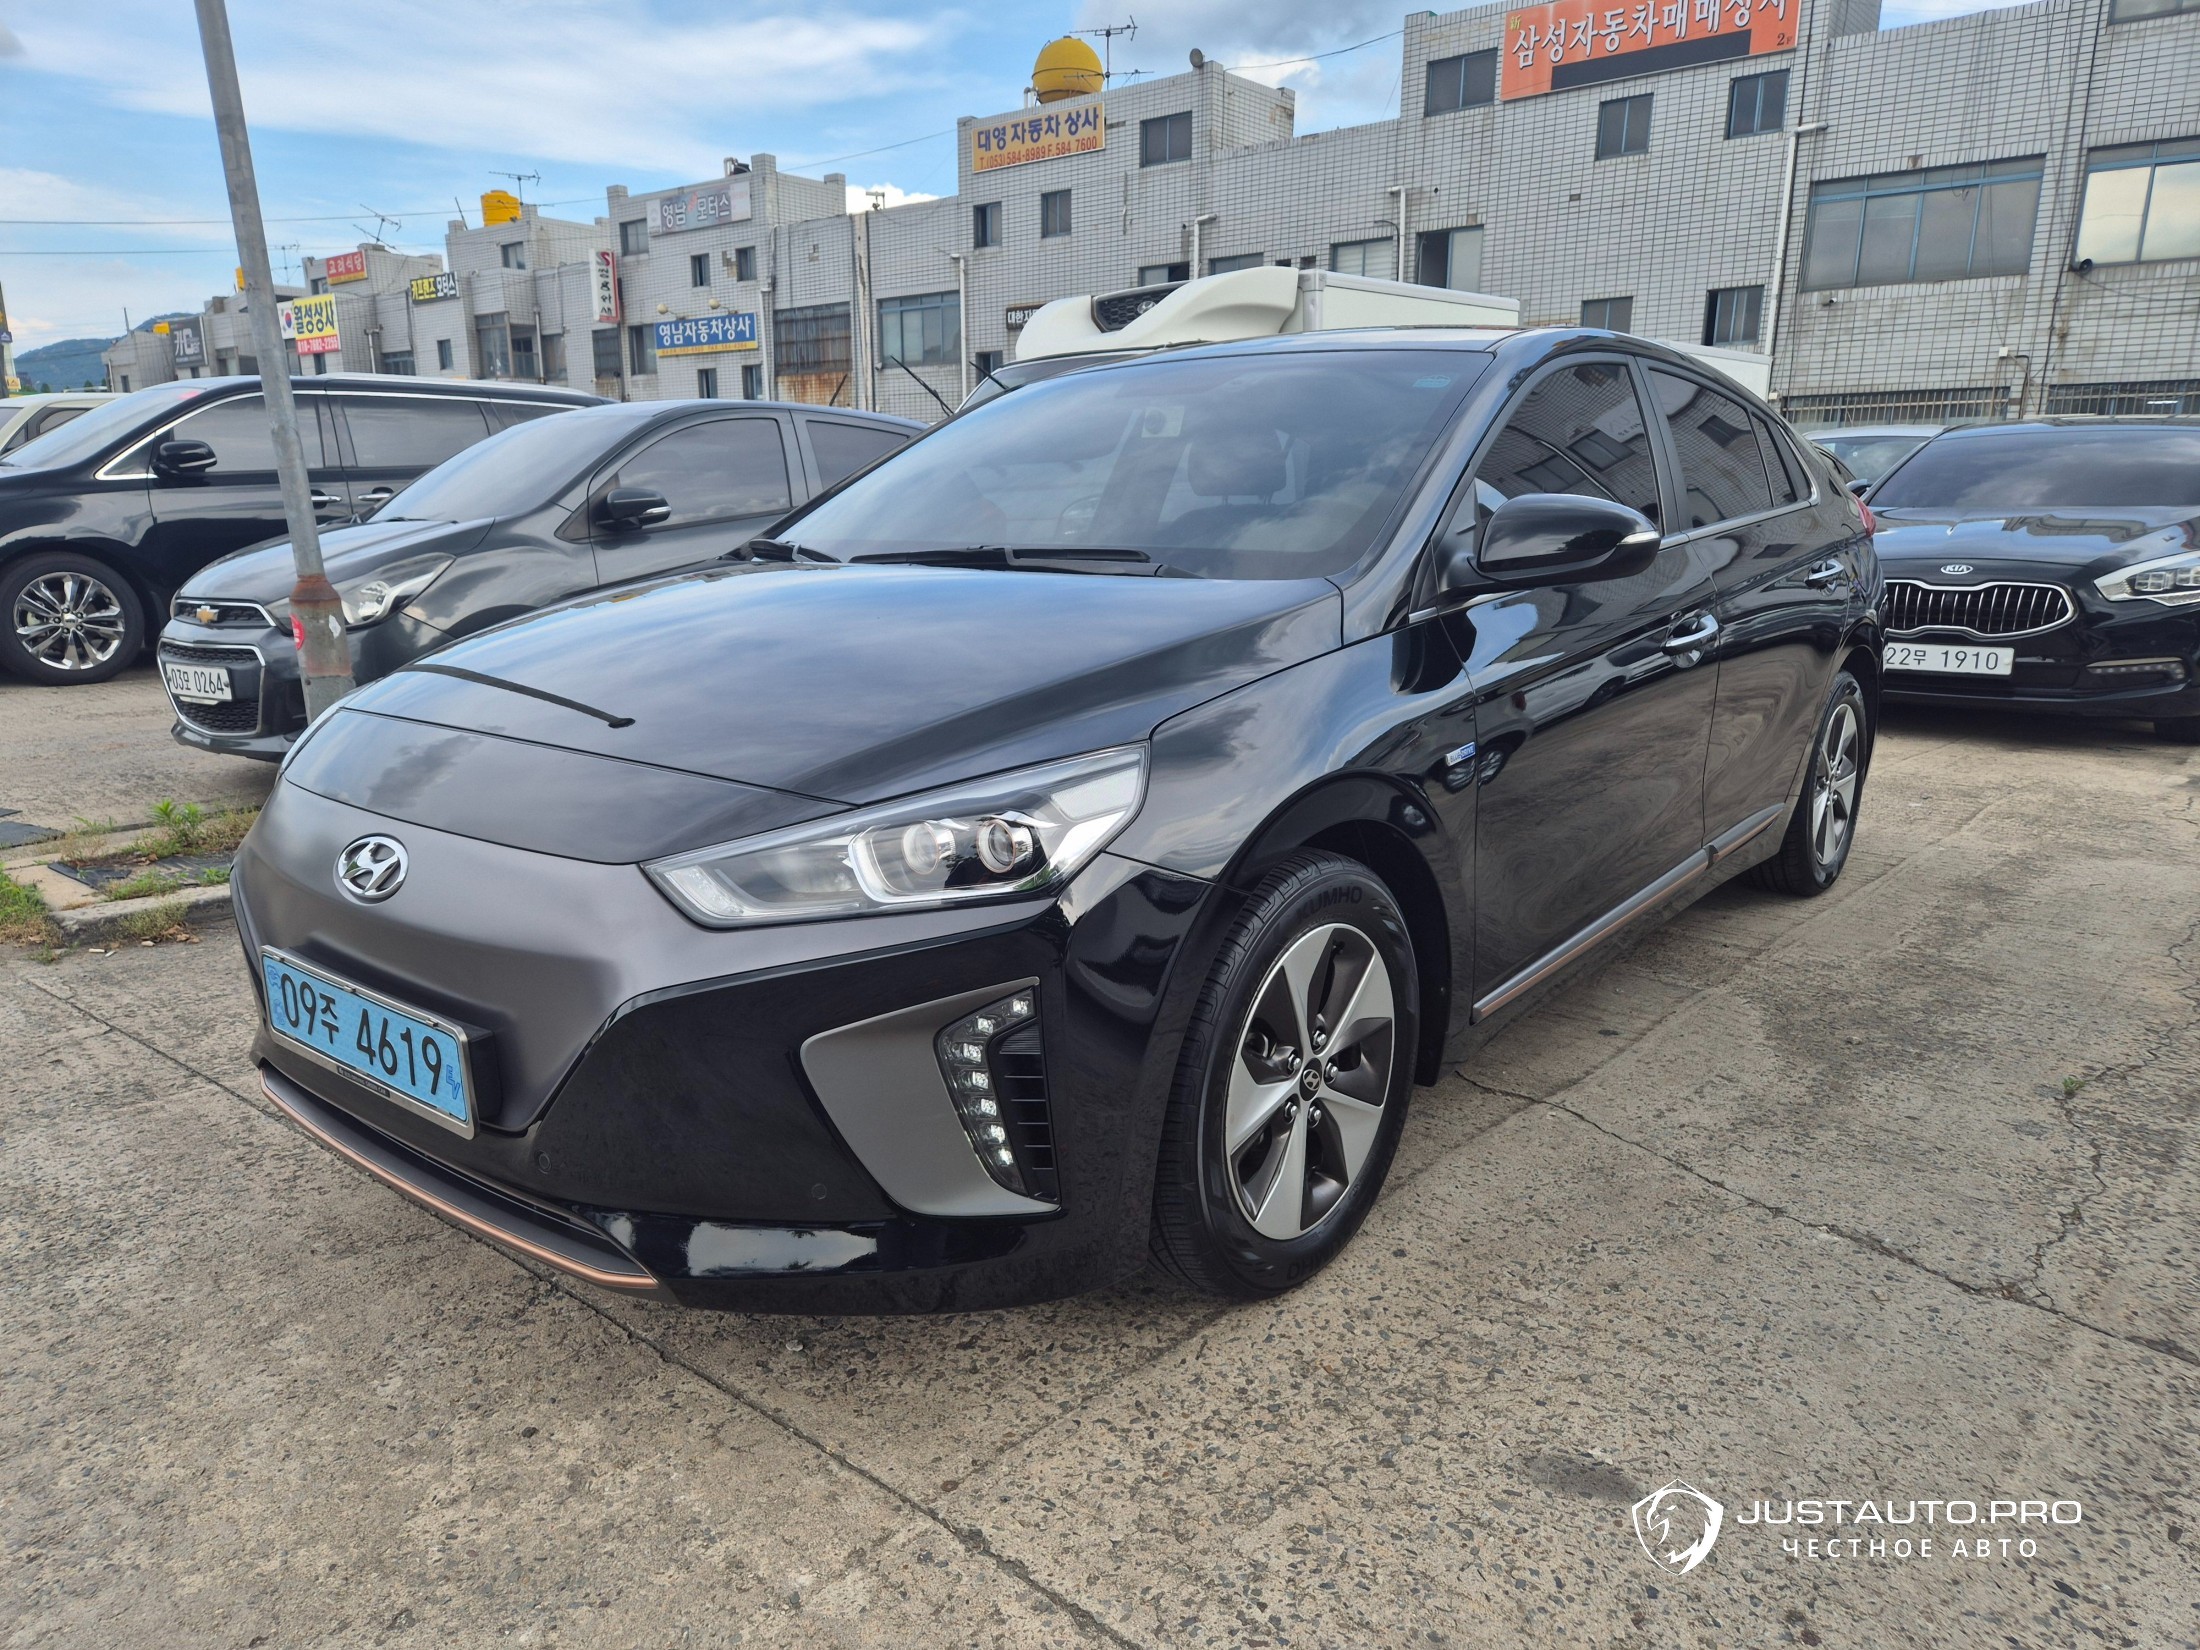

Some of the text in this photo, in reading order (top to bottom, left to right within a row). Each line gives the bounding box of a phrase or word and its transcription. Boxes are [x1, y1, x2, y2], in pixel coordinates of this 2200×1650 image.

[977, 107, 1099, 152] 대영 자동차 상사
[662, 193, 730, 228] 영남 모터스
[658, 315, 751, 346] 영남자동차상사
[1007, 308, 1037, 323] 대한자
[1886, 647, 1999, 670] 22무 1910
[194, 670, 225, 695] 0264
[280, 973, 442, 1096] 09주 4619
[445, 1064, 461, 1100] EV
